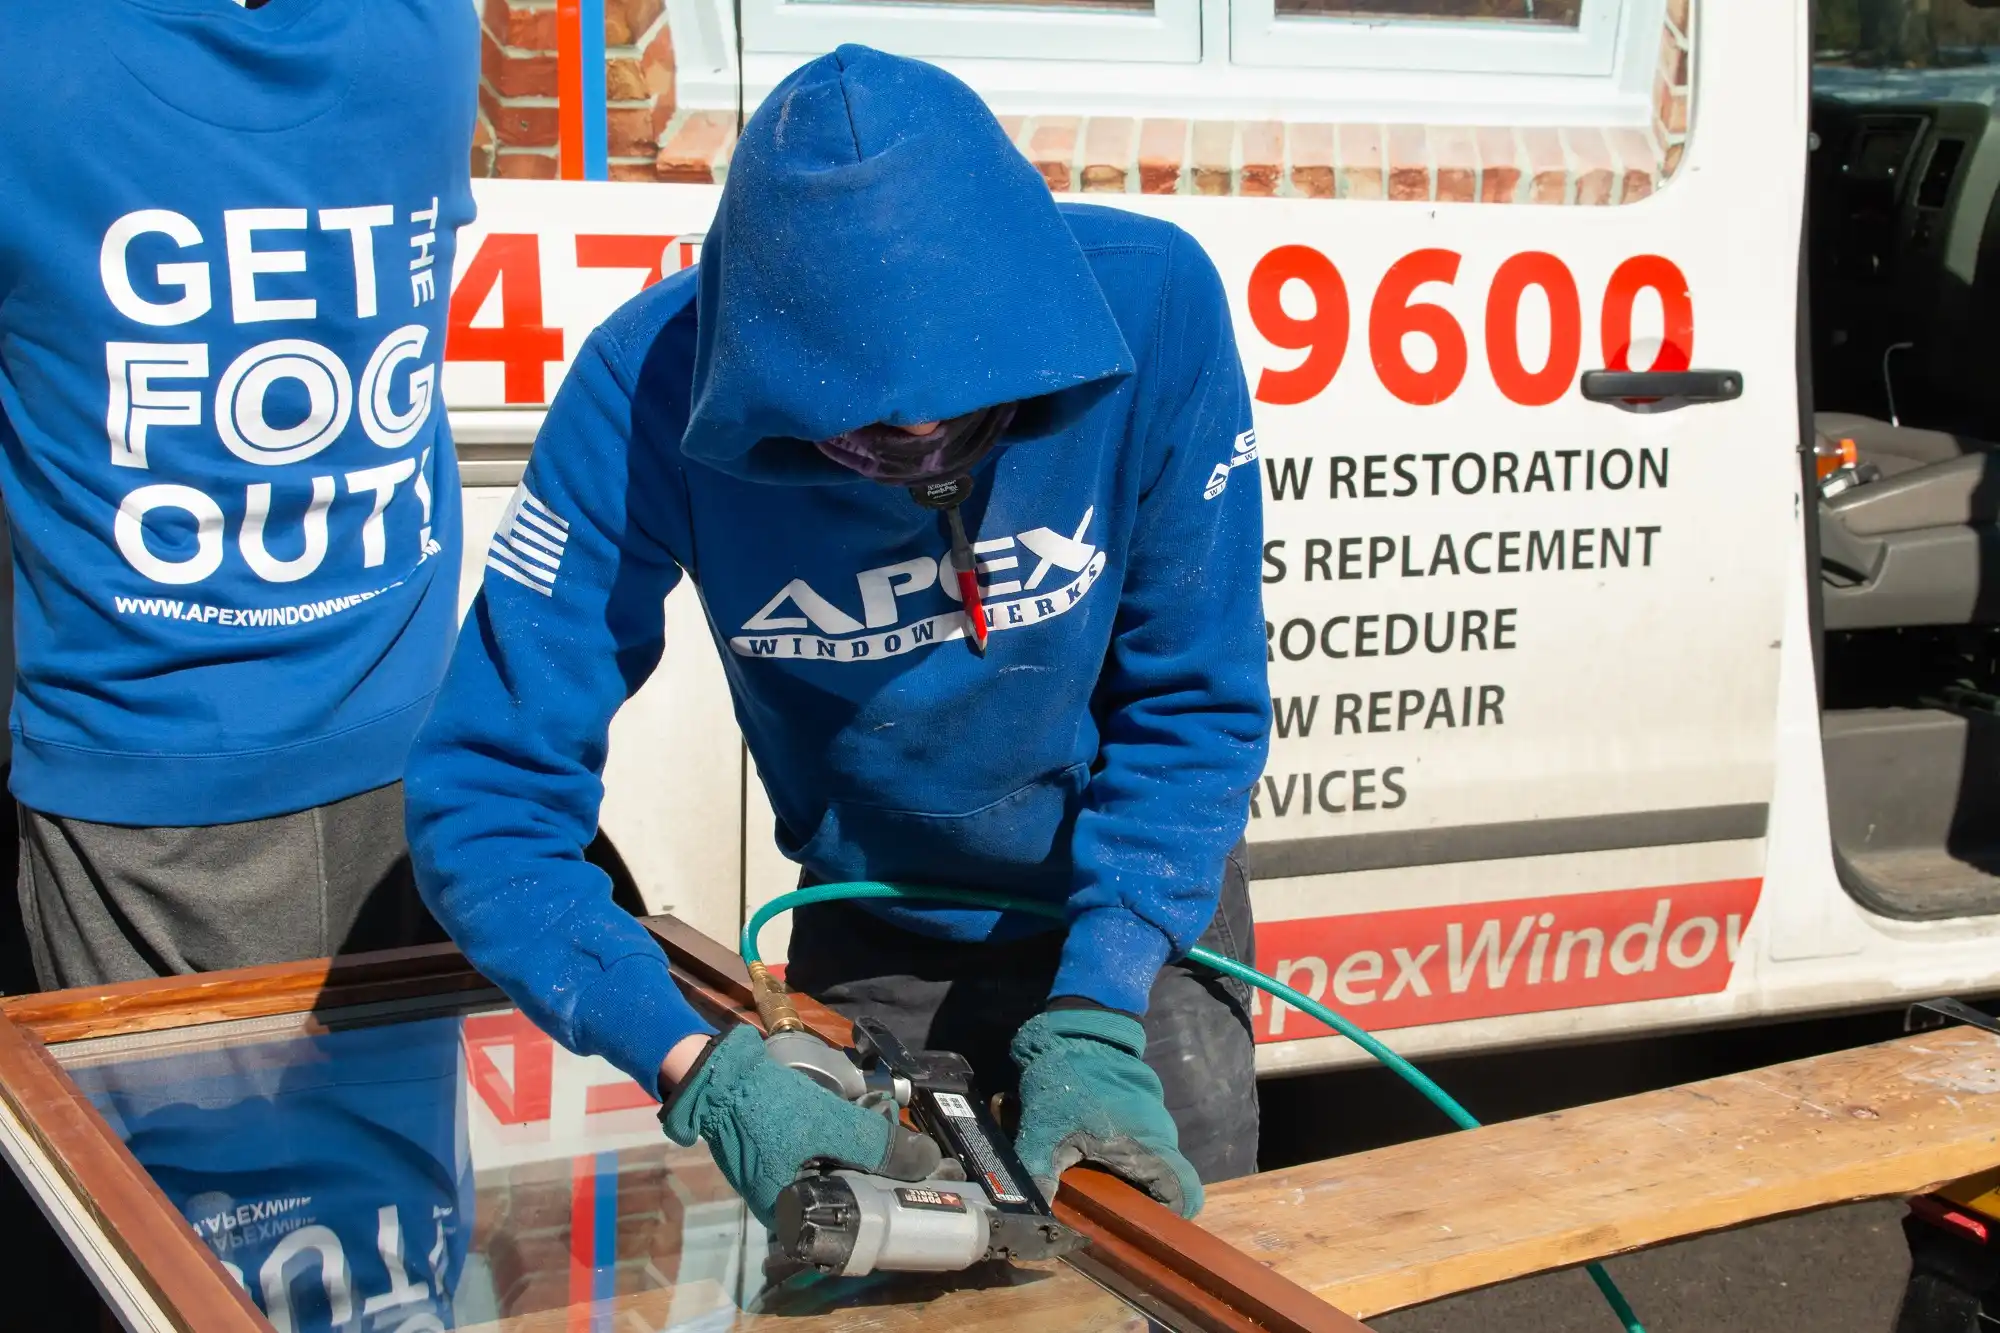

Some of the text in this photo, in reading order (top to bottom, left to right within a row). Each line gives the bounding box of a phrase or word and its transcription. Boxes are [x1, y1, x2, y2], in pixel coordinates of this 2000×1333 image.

[100, 204, 394, 327] GET
[410, 197, 439, 308] THE
[1247, 244, 1695, 407] 9600
[105, 324, 436, 470] FOG
[114, 446, 432, 585] OUT!
[1328, 448, 1669, 499] RESTORATION
[741, 504, 1096, 636] APEX
[1303, 525, 1662, 582] REPLACEMENT
[749, 620, 935, 660] WINDOW
[1264, 607, 1518, 663] OCEDURE
[1334, 684, 1506, 735] REPAIR
[1252, 899, 1741, 1035] pexWindo
